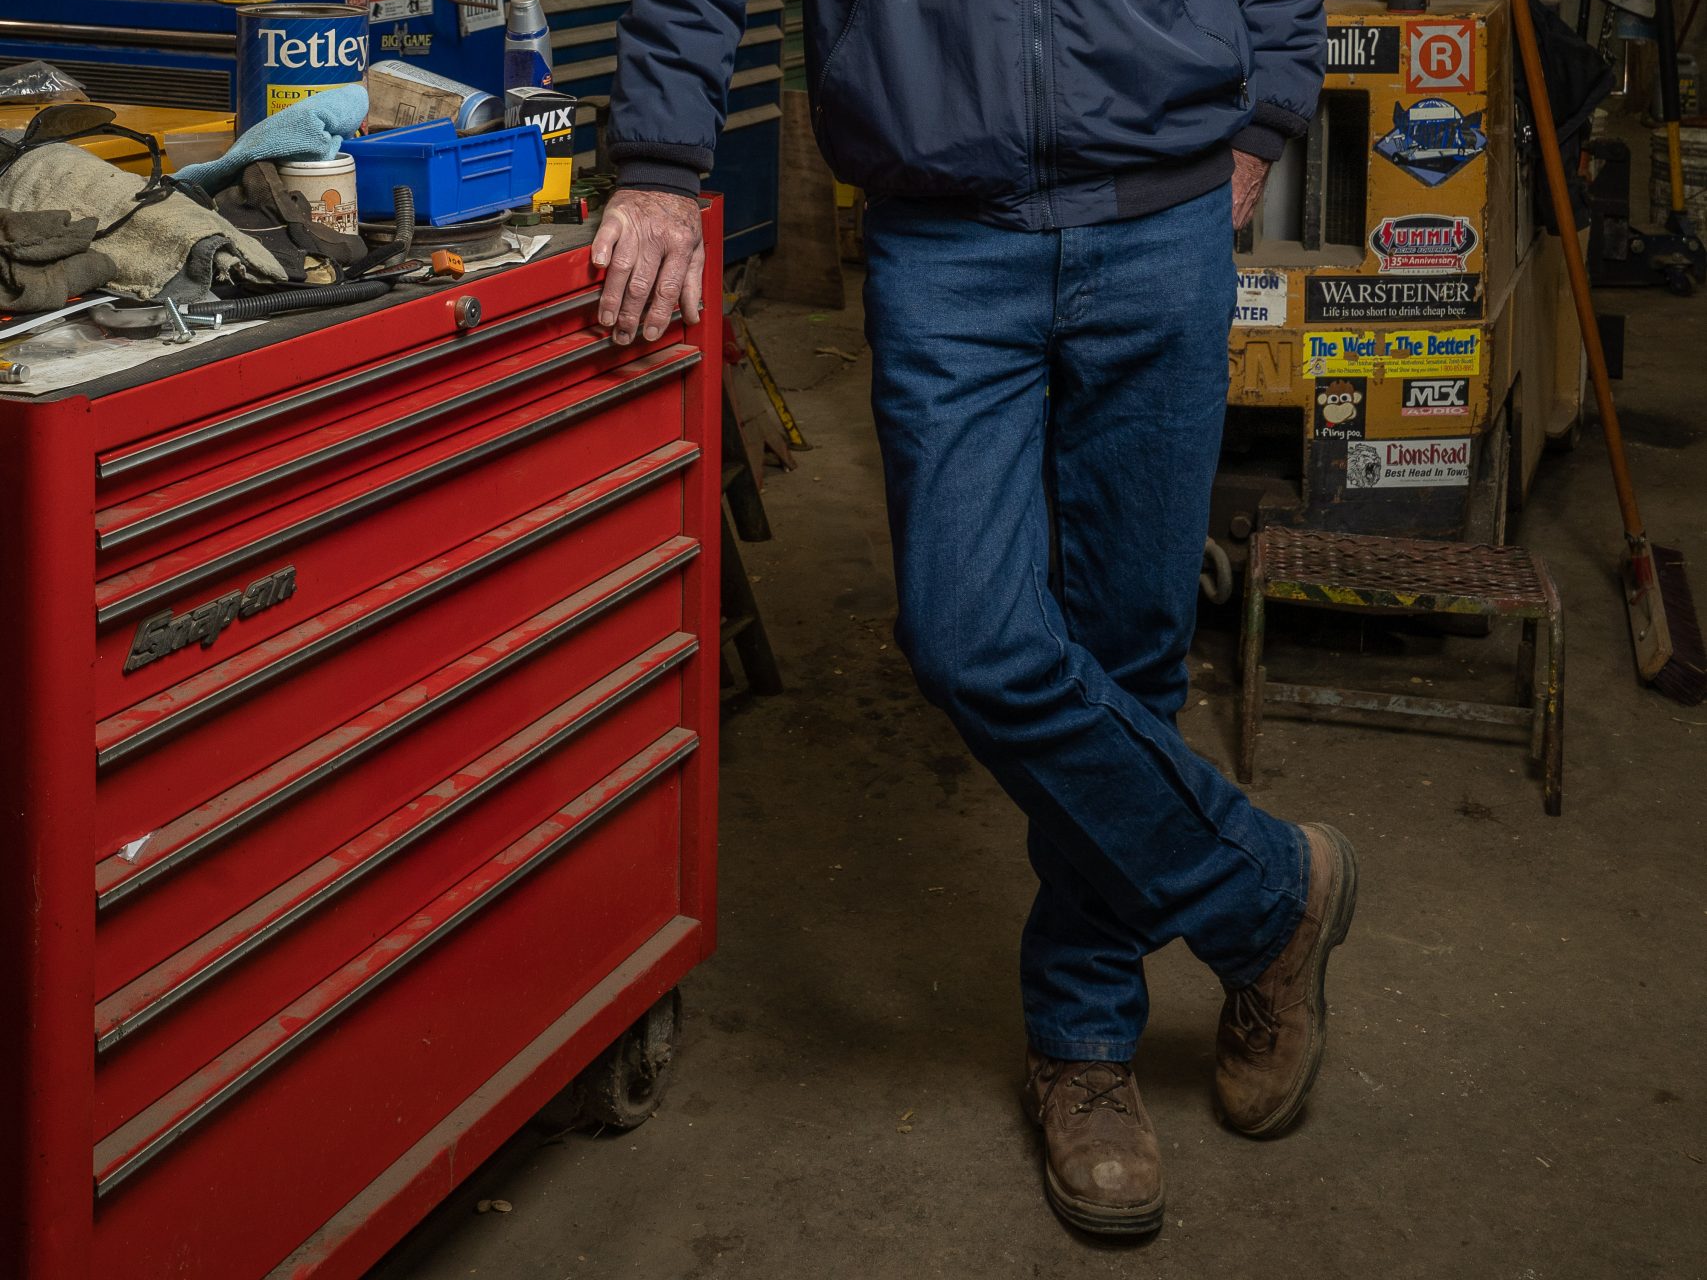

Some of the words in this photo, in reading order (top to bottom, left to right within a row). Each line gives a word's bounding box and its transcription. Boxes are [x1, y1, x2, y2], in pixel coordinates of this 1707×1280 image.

[381, 34, 399, 48] BIG
[258, 28, 369, 72] Tetley
[1429, 42, 1453, 71] R
[271, 88, 300, 99] ICED
[524, 106, 572, 134] WIX
[544, 134, 572, 146] TERS
[1390, 256, 1408, 266] 35th
[1408, 255, 1455, 268] Anniversary
[1236, 275, 1279, 290] NTION
[1319, 281, 1471, 304] WARSTEINER
[1232, 307, 1269, 321] ATER
[1323, 307, 1340, 317] Life
[1342, 307, 1349, 316] is
[1351, 308, 1365, 316] too
[1366, 306, 1387, 316] short
[1389, 307, 1398, 315] to
[1399, 306, 1421, 316] drink
[1422, 306, 1446, 318] cheap
[1447, 306, 1467, 316] beer.
[1309, 336, 1337, 357] The
[1342, 336, 1393, 357] Wettr
[1396, 335, 1423, 356] The
[1427, 334, 1477, 356] Better!
[1405, 380, 1466, 407] MTX
[1320, 427, 1345, 440] fling
[1346, 429, 1363, 440] poo.
[1385, 442, 1468, 466] Lionshead
[1384, 469, 1406, 478] Best
[1407, 468, 1431, 478] Head
[1434, 468, 1443, 477] In
[1446, 467, 1469, 476] Town
[123, 565, 297, 676] Snap-on
